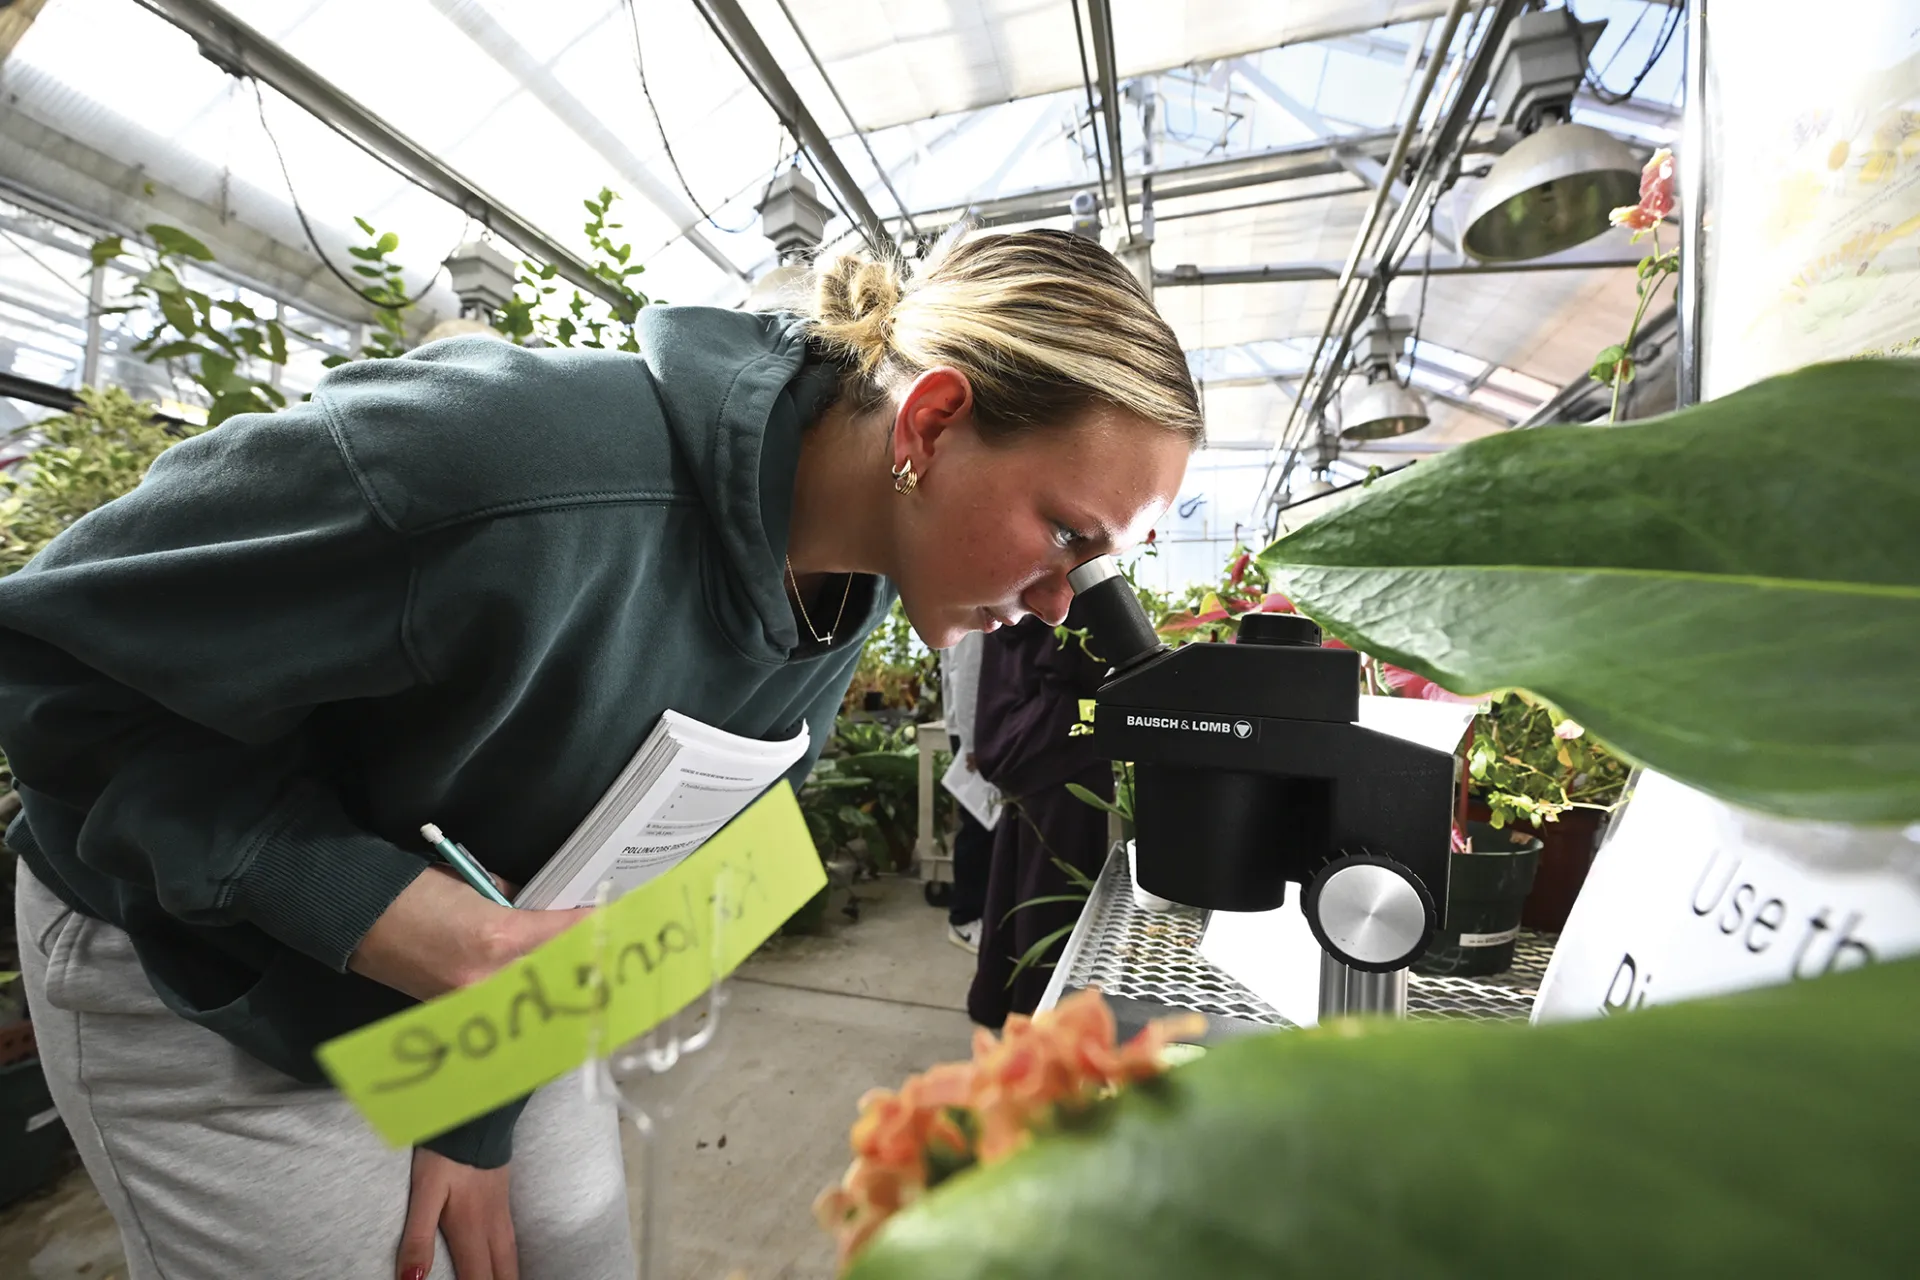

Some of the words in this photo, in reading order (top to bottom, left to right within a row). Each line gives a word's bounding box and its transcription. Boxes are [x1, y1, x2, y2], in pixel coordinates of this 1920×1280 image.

[1126, 715, 1179, 729] BAUSCH
[1180, 719, 1191, 731] &
[1192, 720, 1231, 734] LOMB
[621, 844, 672, 854] POLLINATORS
[1691, 849, 1785, 953] Use
